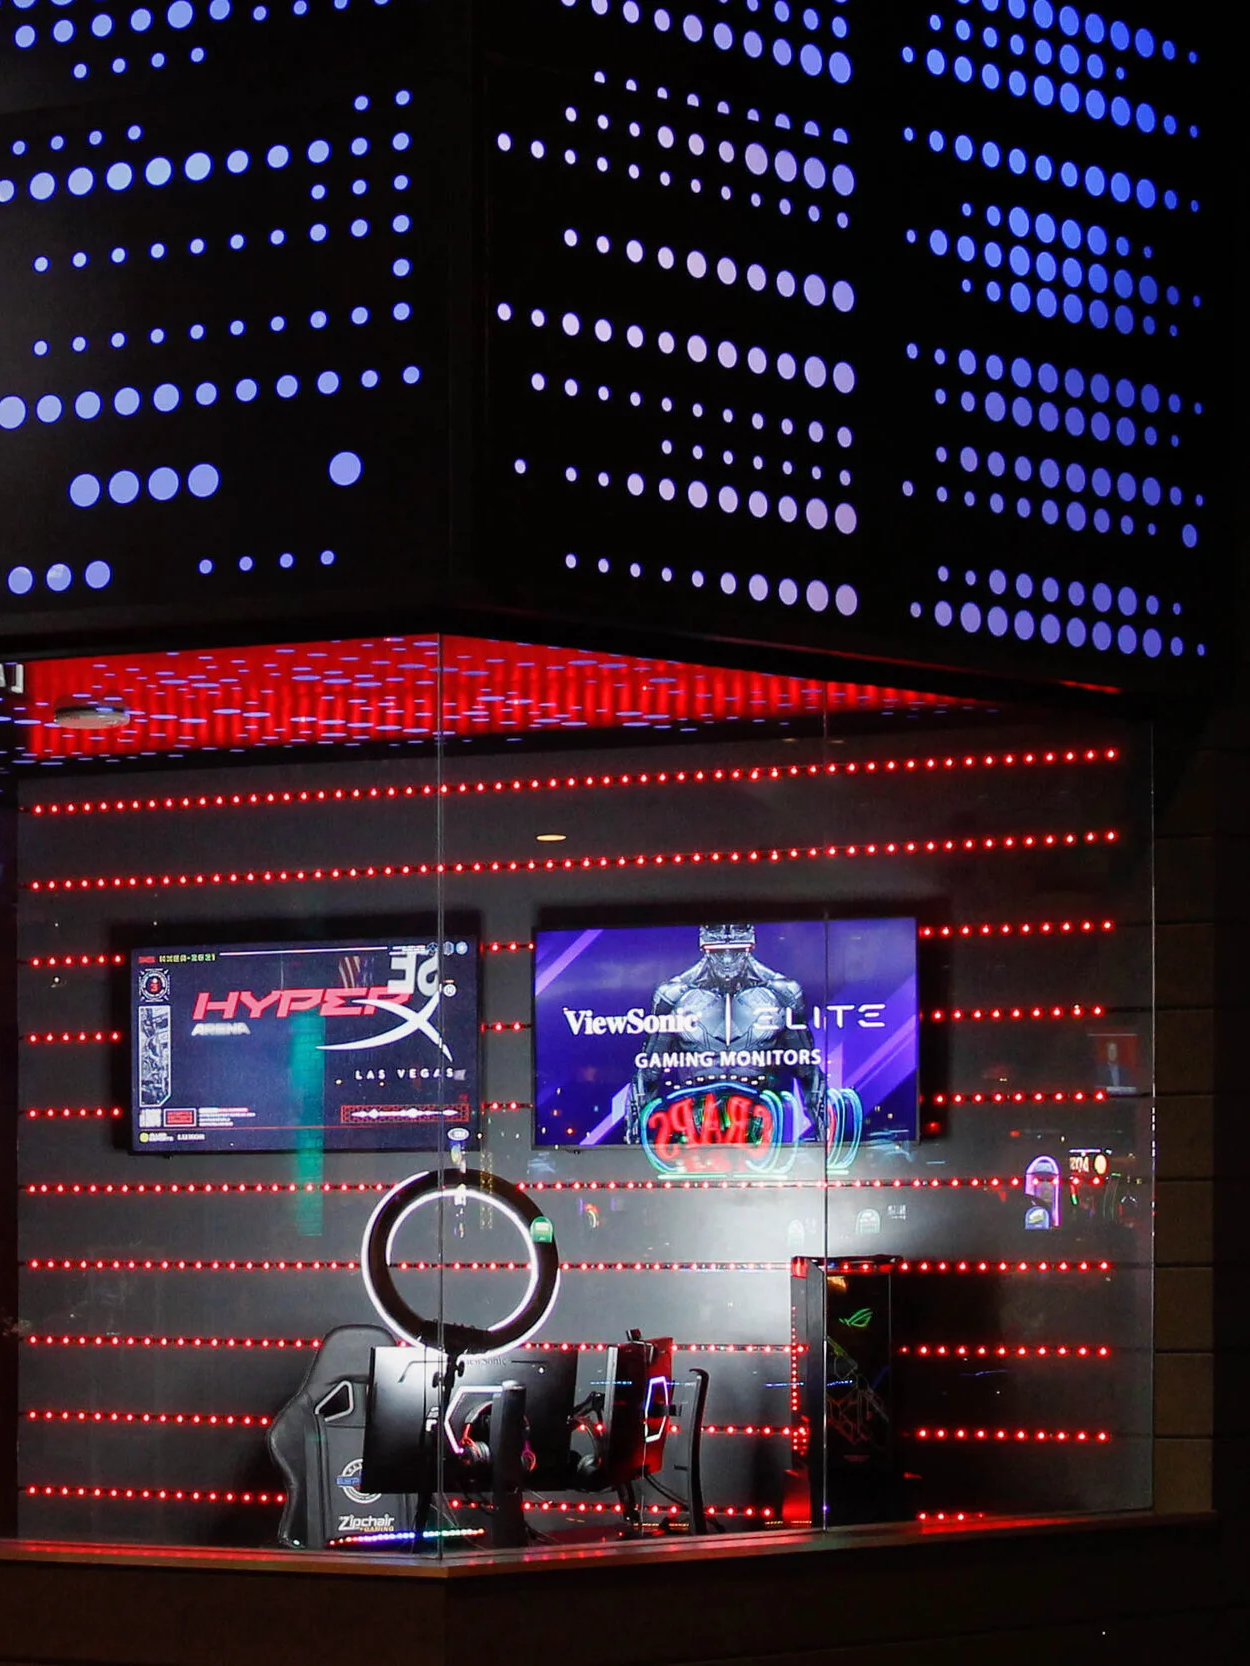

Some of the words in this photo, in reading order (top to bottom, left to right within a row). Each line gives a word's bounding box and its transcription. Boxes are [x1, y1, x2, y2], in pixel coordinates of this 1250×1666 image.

[564, 1008, 701, 1035] ViewSonic
[752, 1003, 887, 1030] ELITE
[191, 1022, 251, 1036] ARENA
[634, 1052, 715, 1068] GAMING
[719, 1048, 823, 1067] MONITORS
[354, 1069, 386, 1080] LAS
[397, 1067, 454, 1079] VEGAS
[338, 1513, 395, 1531] Zipchair
